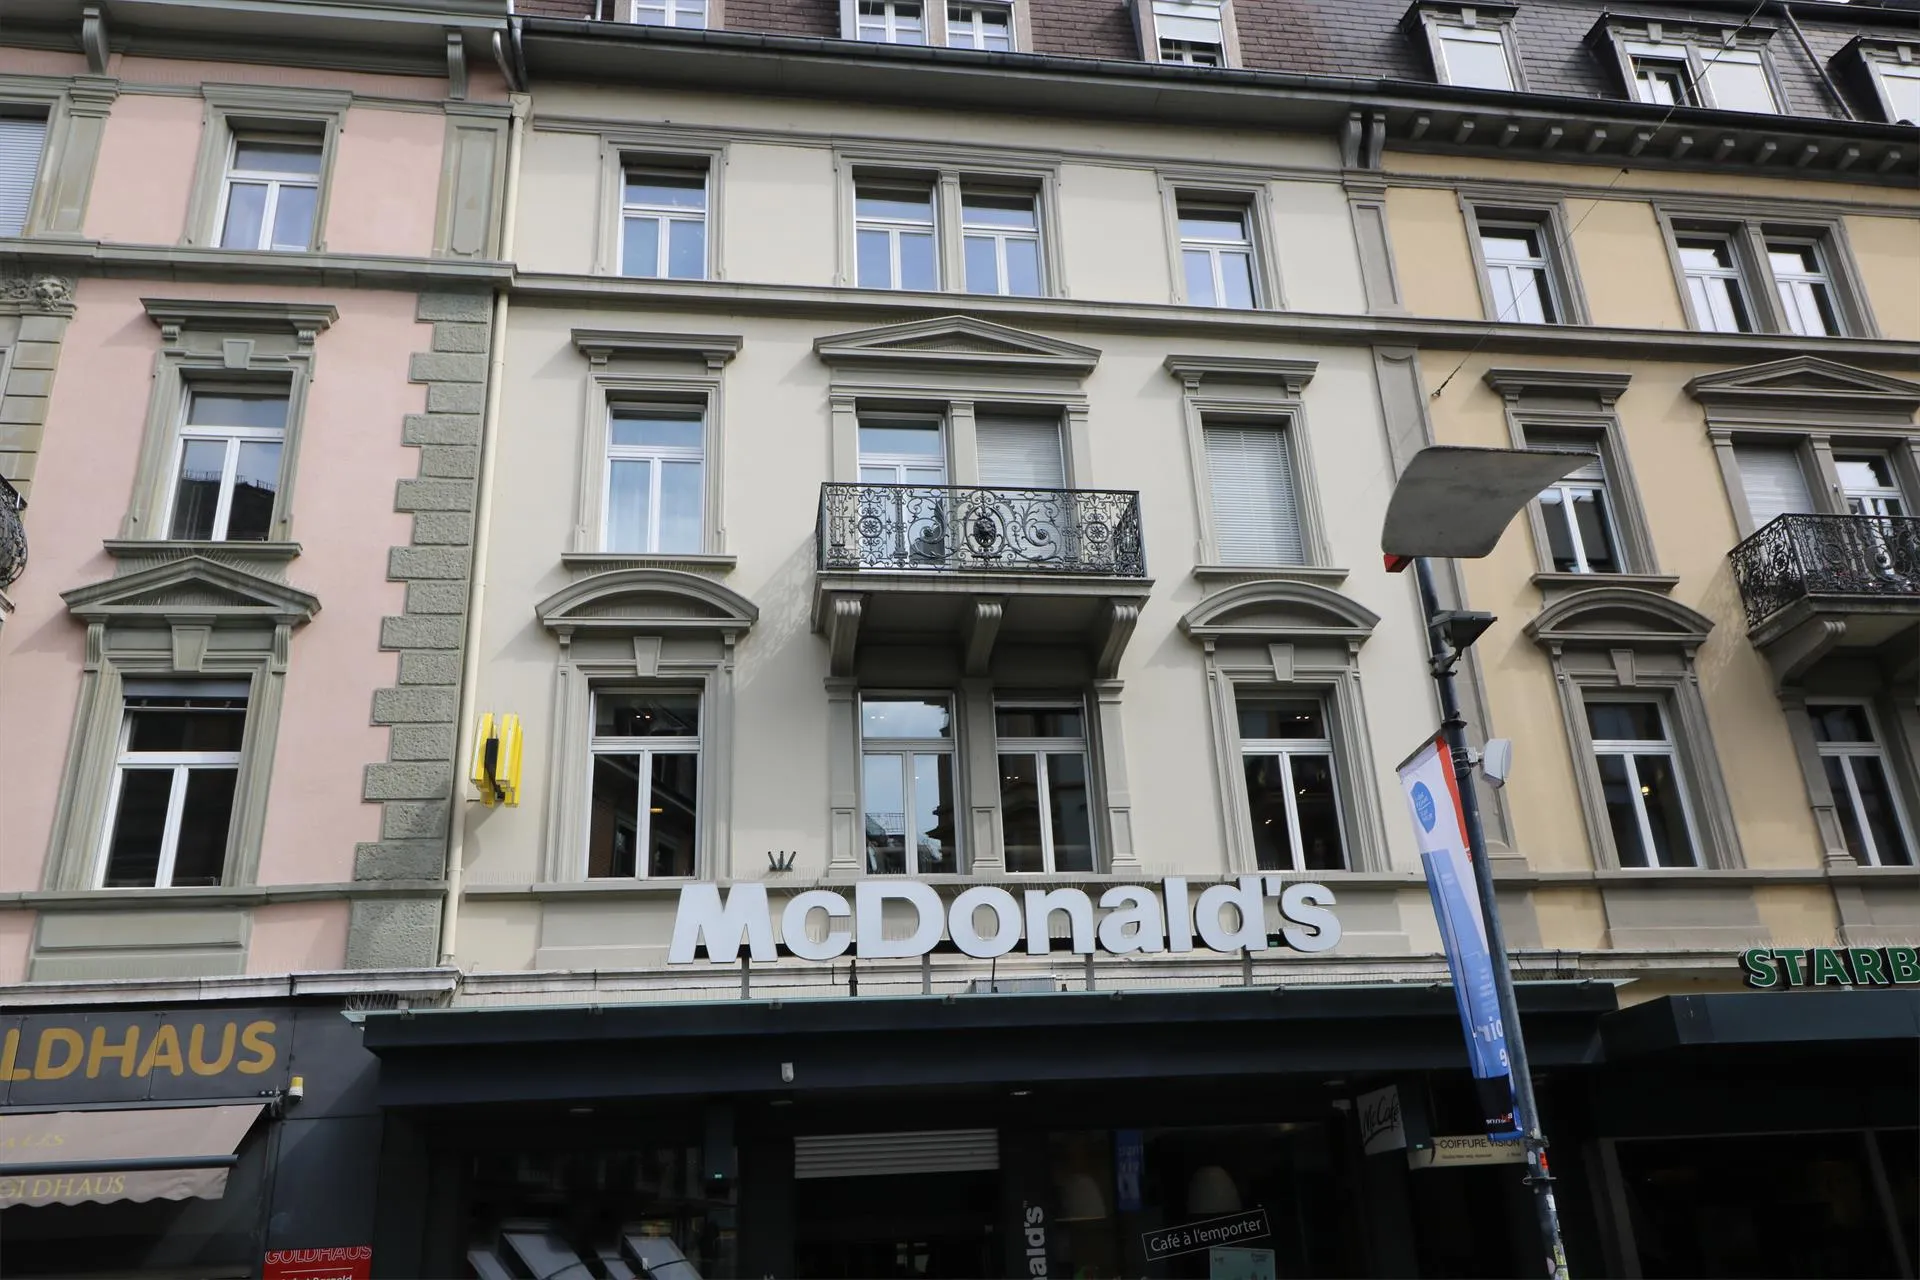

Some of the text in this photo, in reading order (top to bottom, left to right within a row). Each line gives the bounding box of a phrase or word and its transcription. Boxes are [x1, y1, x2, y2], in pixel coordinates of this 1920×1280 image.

[668, 876, 1343, 964] McDonald's
[1744, 946, 1920, 988] STARB
[0, 1020, 277, 1081] LDHAUS
[1439, 1138, 1520, 1149] COIFFURE VISION
[1023, 1206, 1048, 1280] ald's
[1150, 1218, 1262, 1252] Café à l'emporter
